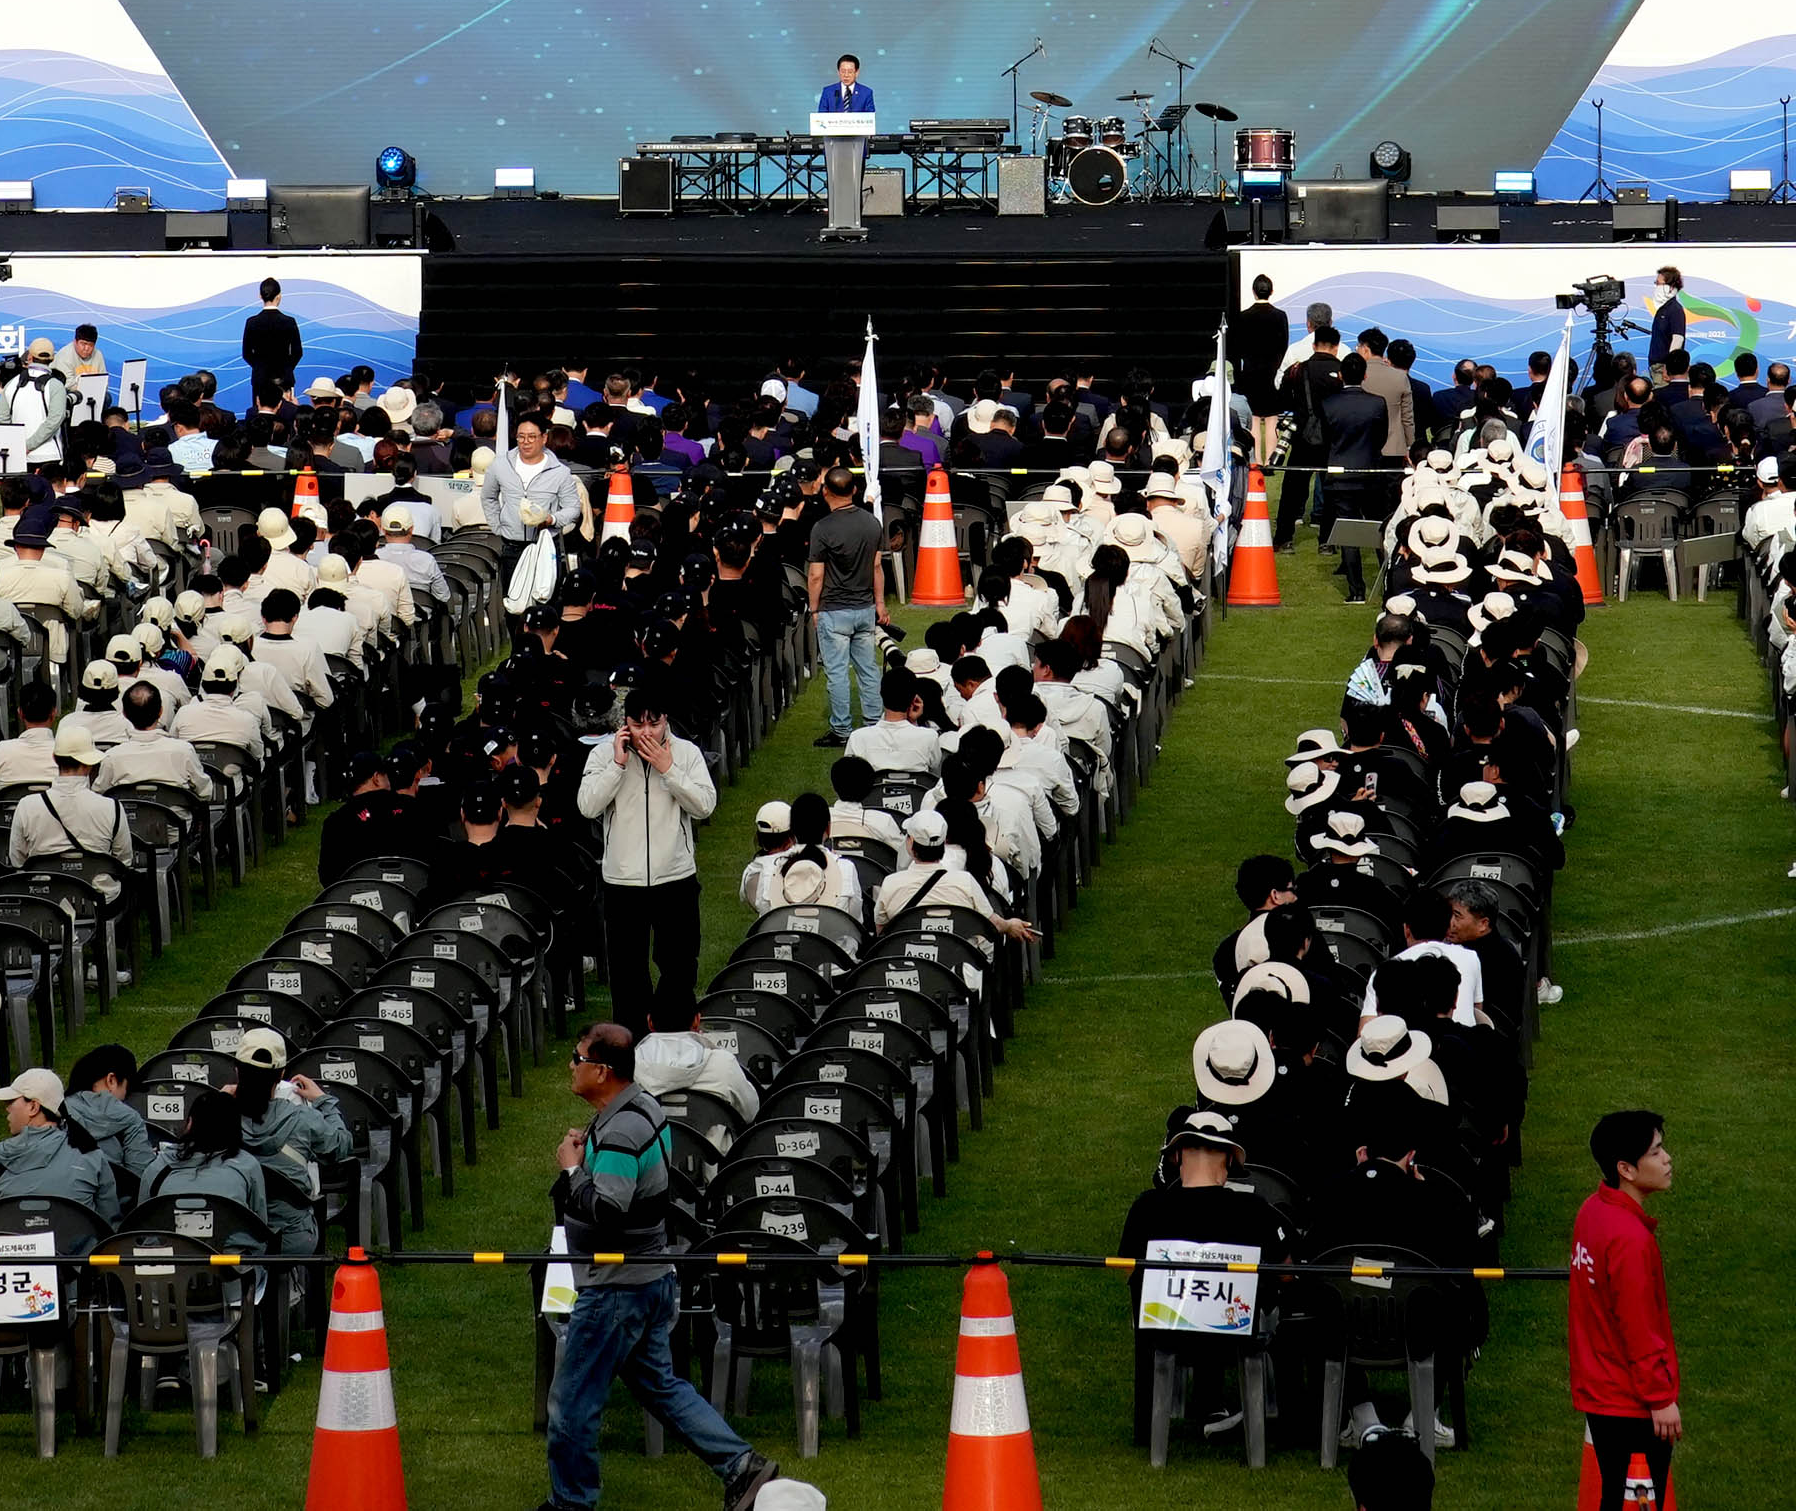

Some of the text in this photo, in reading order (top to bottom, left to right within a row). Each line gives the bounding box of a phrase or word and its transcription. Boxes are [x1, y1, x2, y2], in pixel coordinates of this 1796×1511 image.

[755, 979, 786, 989] H-263
[888, 977, 919, 988] D-145
[380, 1008, 412, 1019] B-465
[323, 1069, 356, 1081] C-300
[153, 1101, 180, 1114] C-68
[778, 1139, 814, 1152] D-364
[761, 1184, 790, 1195] D-44
[767, 1221, 806, 1235] D-239
[1167, 1277, 1233, 1304] 나주시
